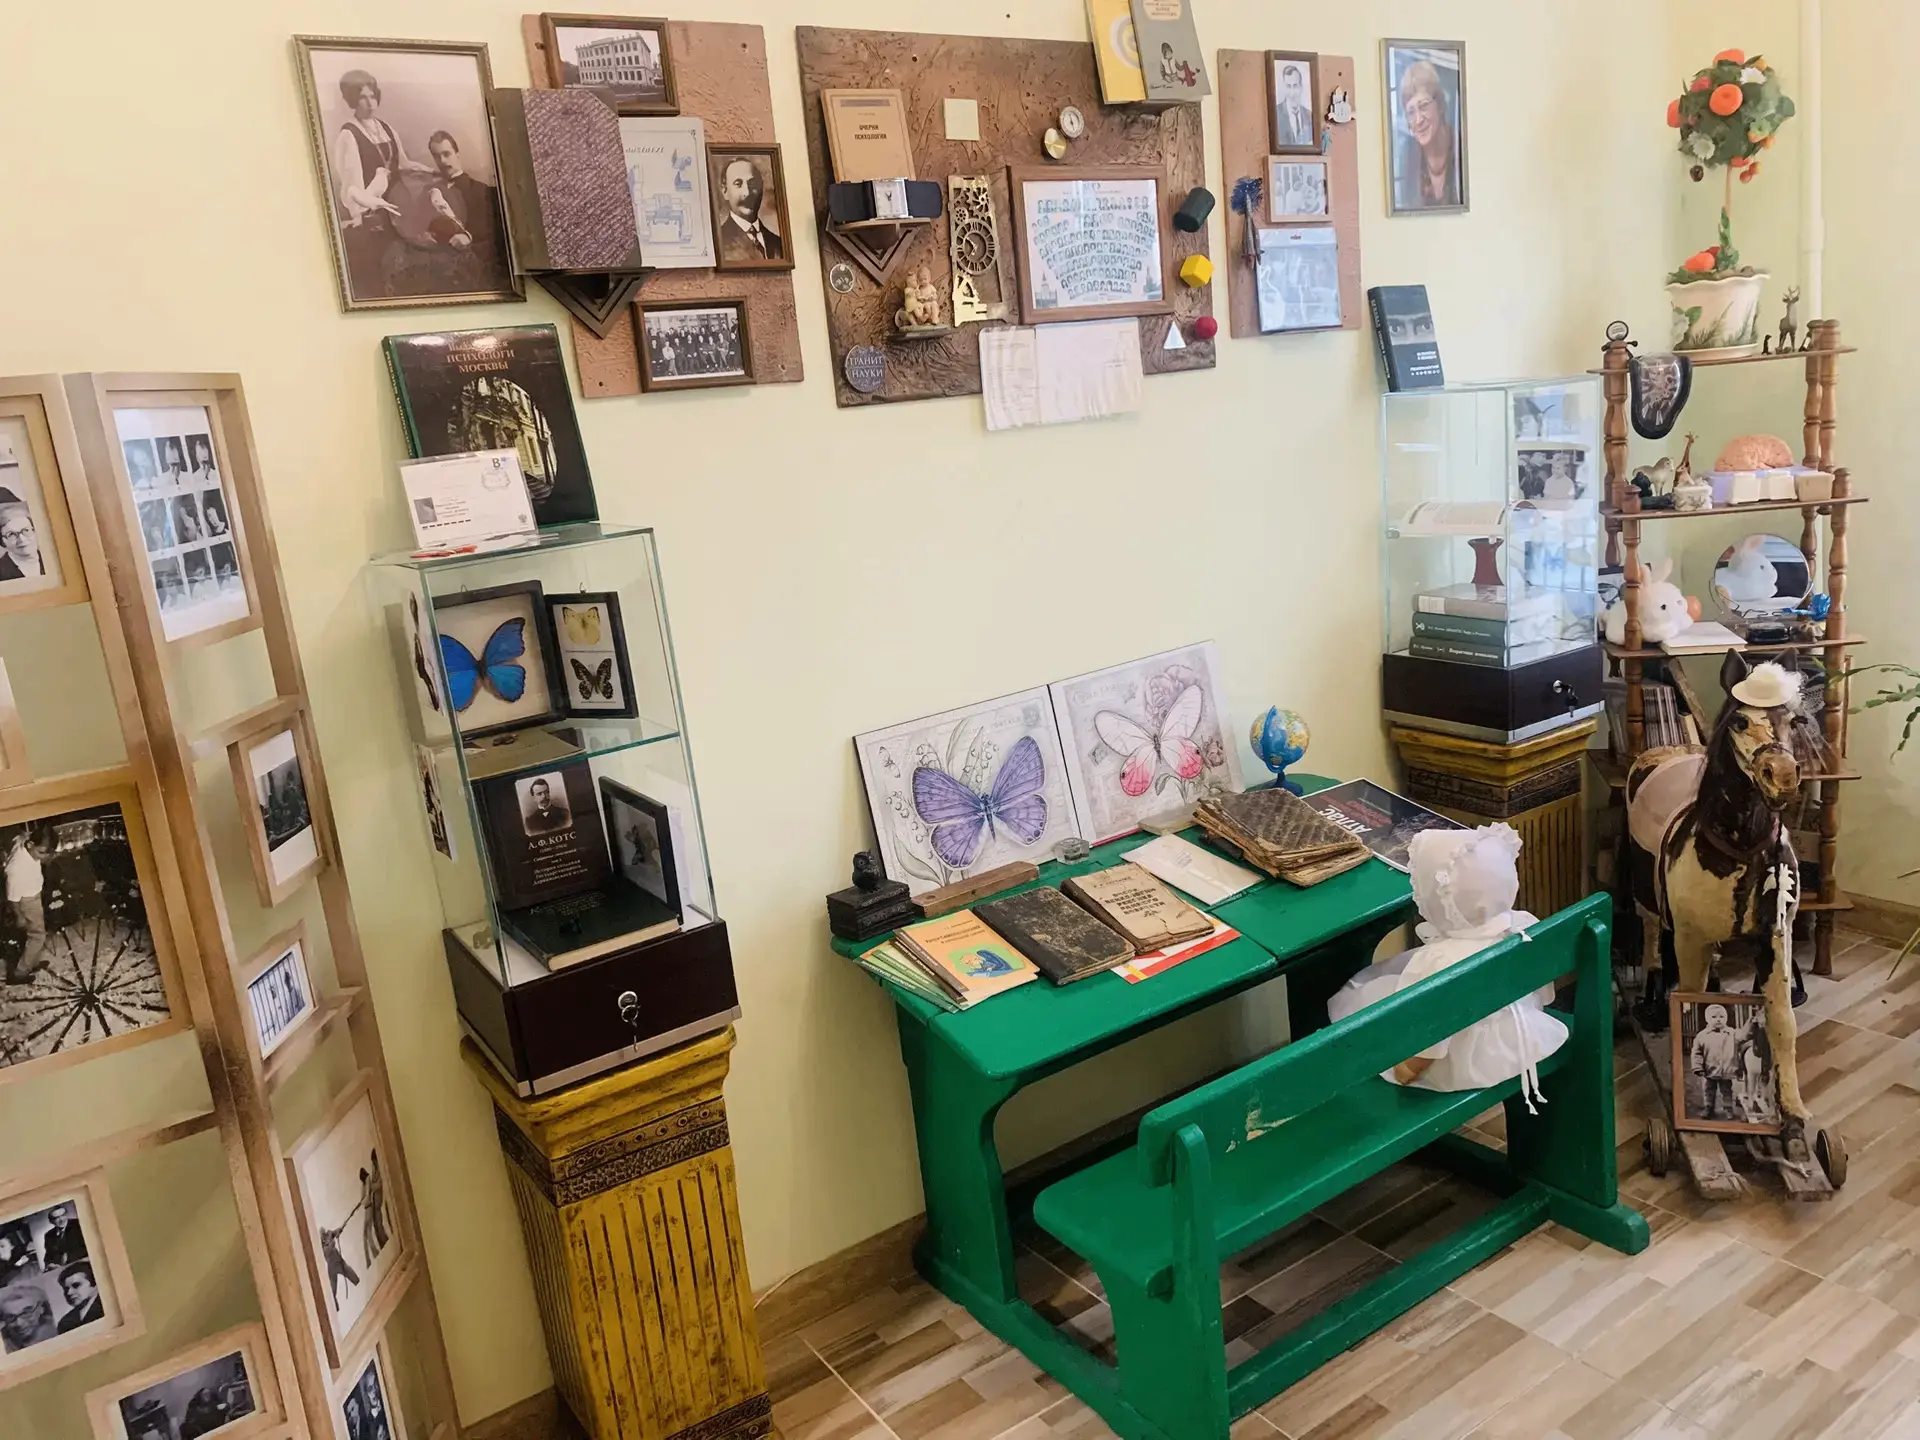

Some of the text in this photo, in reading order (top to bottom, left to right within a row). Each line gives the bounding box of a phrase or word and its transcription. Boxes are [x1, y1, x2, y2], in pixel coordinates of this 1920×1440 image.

[446, 349, 515, 363] ПСИХОЛОГИ
[850, 356, 883, 365] ГРАНИТ
[458, 361, 509, 373] МОСКВЫ
[851, 369, 883, 378] НАУКИ
[1318, 808, 1373, 834] Атлас
[548, 831, 577, 845] КОТС
